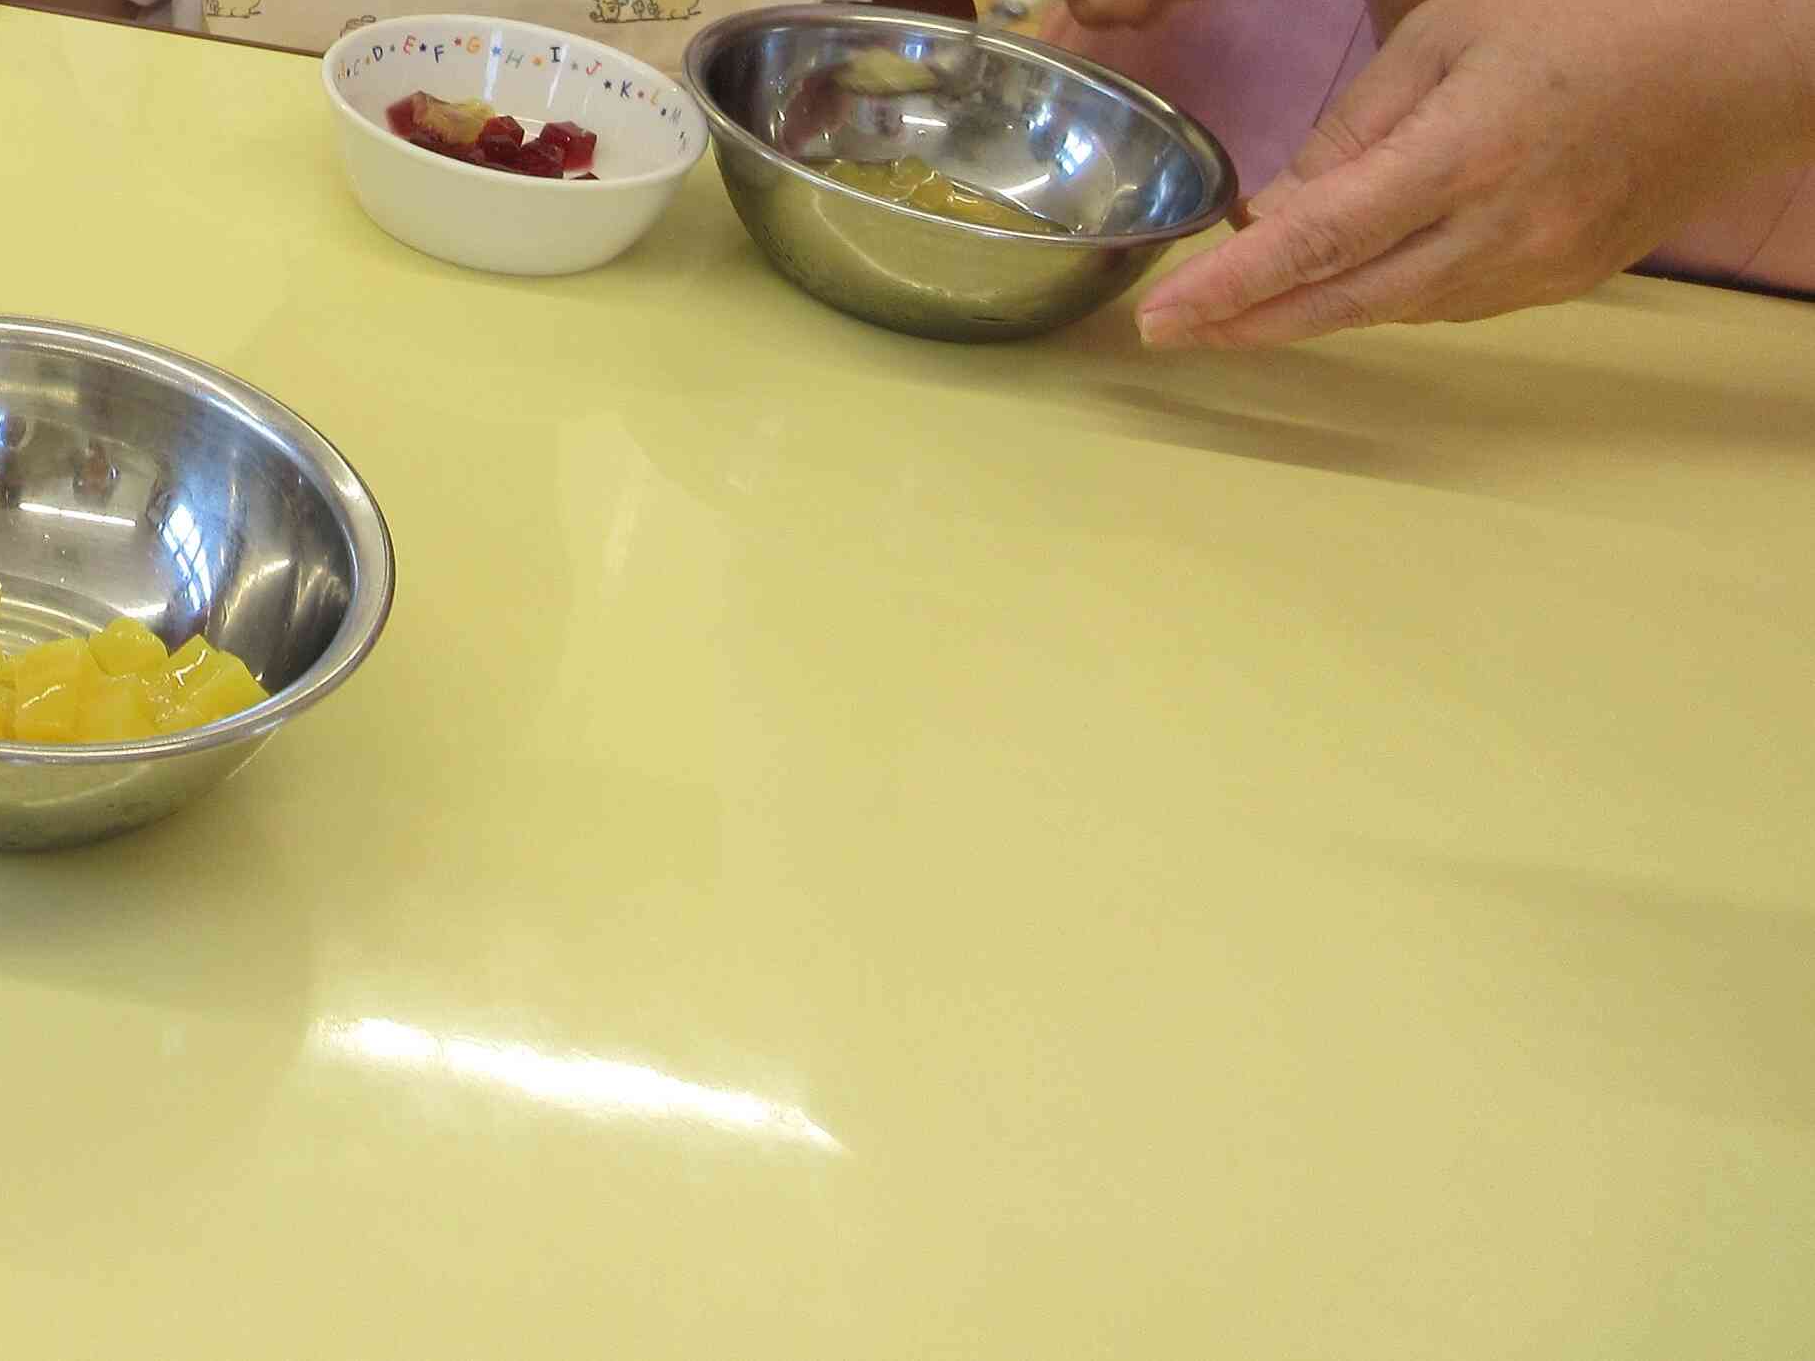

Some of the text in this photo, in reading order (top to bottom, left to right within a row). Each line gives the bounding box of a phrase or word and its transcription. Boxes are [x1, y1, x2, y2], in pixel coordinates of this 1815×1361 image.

[372, 45, 383, 62] D
[402, 34, 417, 55] E
[434, 44, 445, 63] F
[466, 36, 481, 54] G
[505, 48, 524, 69] H
[549, 46, 561, 63] I
[586, 60, 602, 76] J
[619, 80, 633, 98] K
